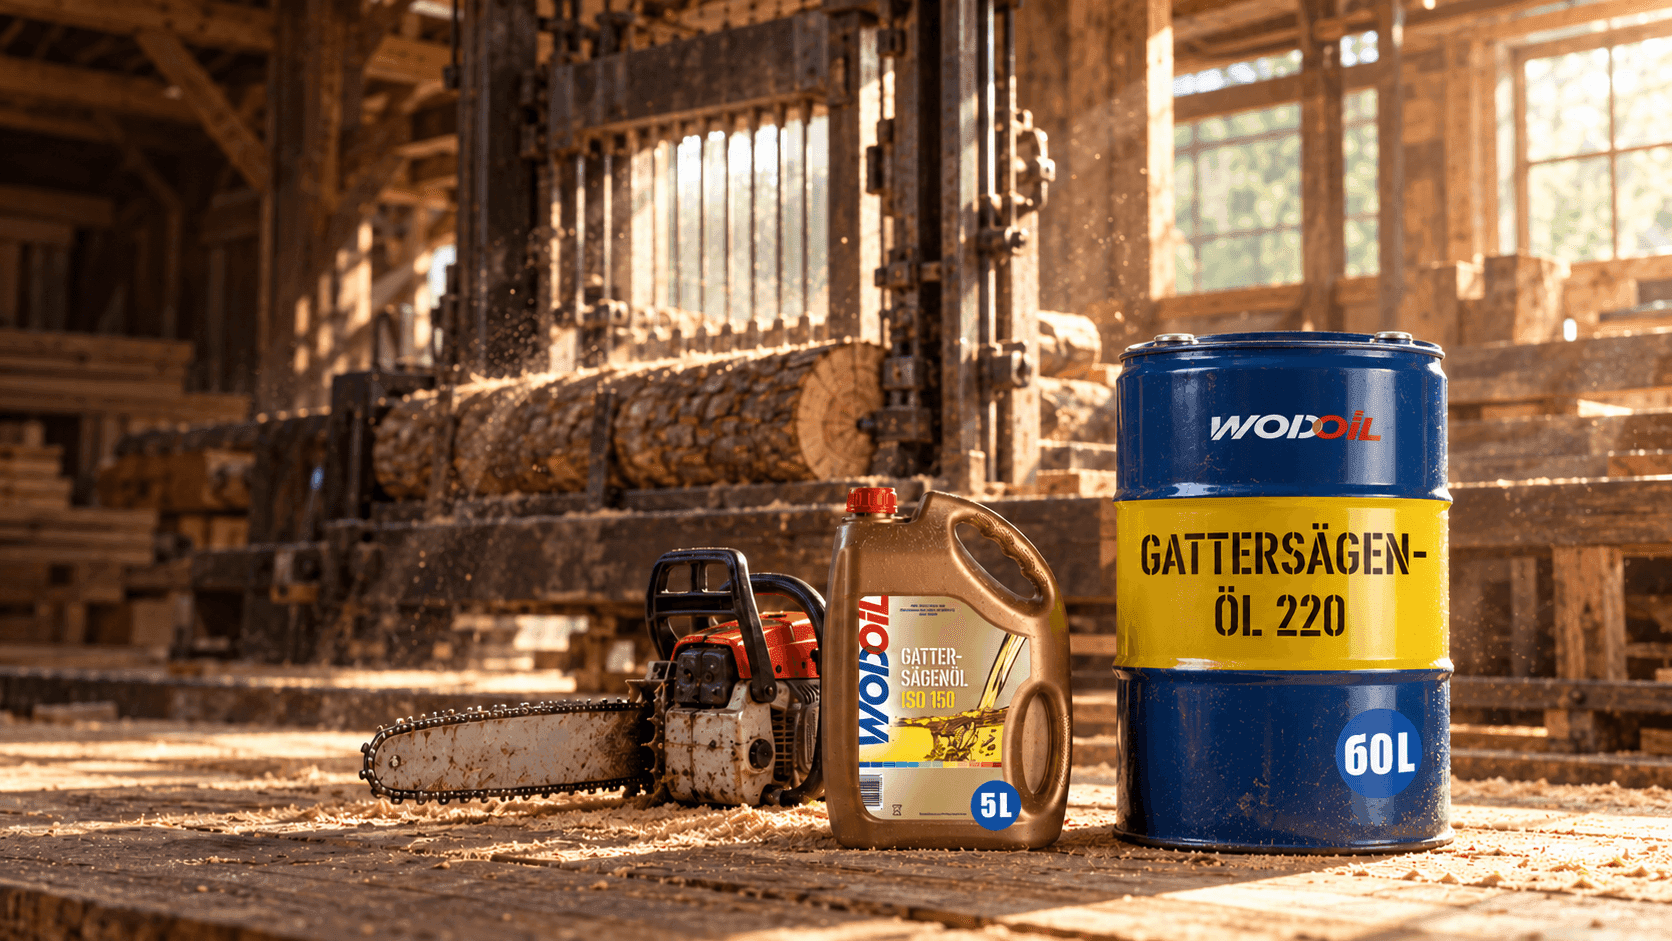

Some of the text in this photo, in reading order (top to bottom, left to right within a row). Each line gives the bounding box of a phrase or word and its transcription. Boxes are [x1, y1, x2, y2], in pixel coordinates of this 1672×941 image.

[1141, 523, 1427, 575] GATTERSÄGEN-
[1215, 586, 1345, 637] ÖL 220
[901, 647, 963, 665] GATTER-
[901, 665, 969, 687] SÄGENÖL
[901, 690, 956, 709] ISO 150
[1345, 732, 1415, 776] 60L
[980, 792, 1012, 818] 5L
